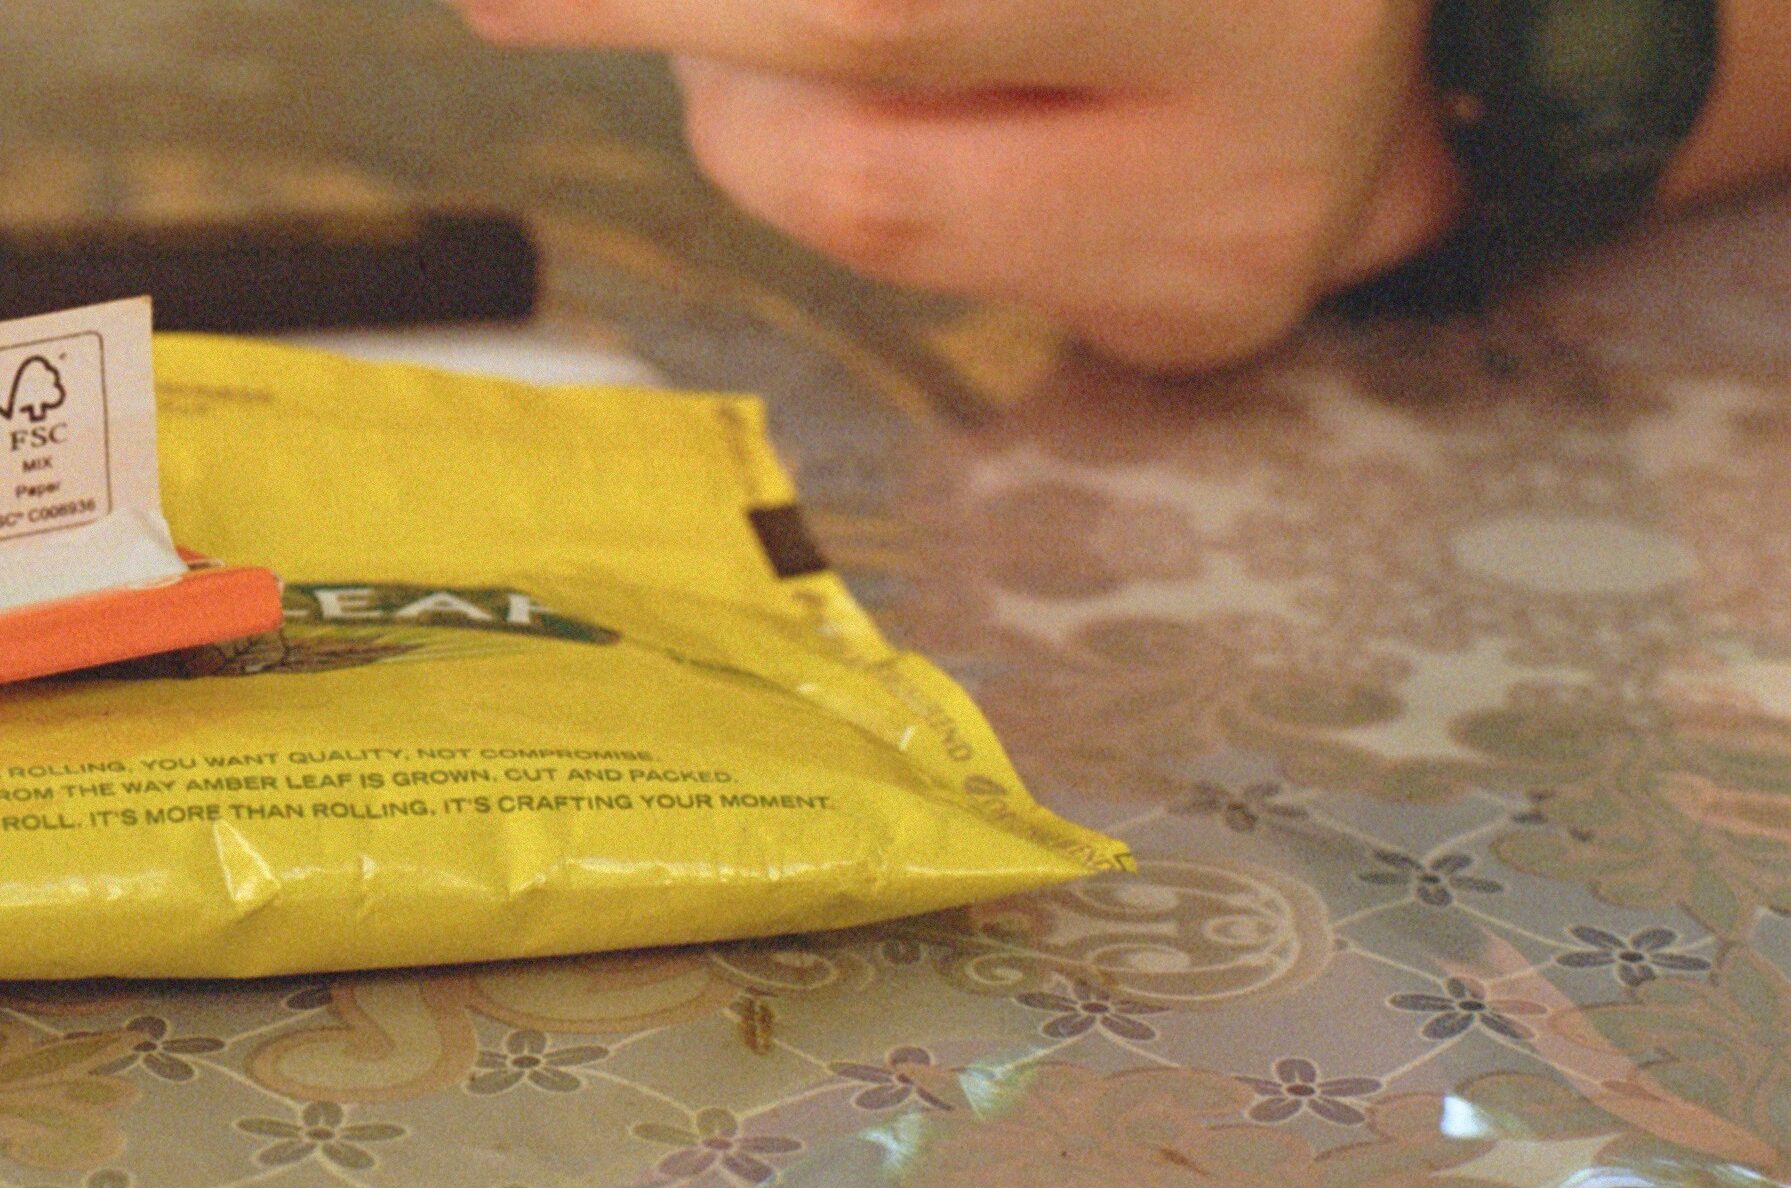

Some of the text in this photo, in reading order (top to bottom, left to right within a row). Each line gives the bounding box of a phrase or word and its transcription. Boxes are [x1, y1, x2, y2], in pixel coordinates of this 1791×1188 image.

[9, 422, 68, 452] FSC
[22, 456, 53, 473] MIX
[144, 758, 197, 771] YOU
[206, 752, 279, 767] WANT
[417, 747, 472, 760] NOT
[61, 781, 117, 798] THE
[121, 778, 177, 794] WAY
[186, 775, 279, 793] AMBER
[285, 773, 353, 790] LEAF
[360, 772, 385, 789] IS
[503, 767, 558, 783] CUT
[567, 768, 623, 783] AND
[630, 768, 739, 784] PACKED.
[2, 813, 82, 831] ROLL.
[89, 808, 139, 827] IT'S
[145, 803, 222, 825] MORE
[230, 803, 304, 820] THAN
[444, 795, 492, 814] IT'S
[497, 793, 634, 813] CRAFTING
[639, 793, 713, 810] YOUR
